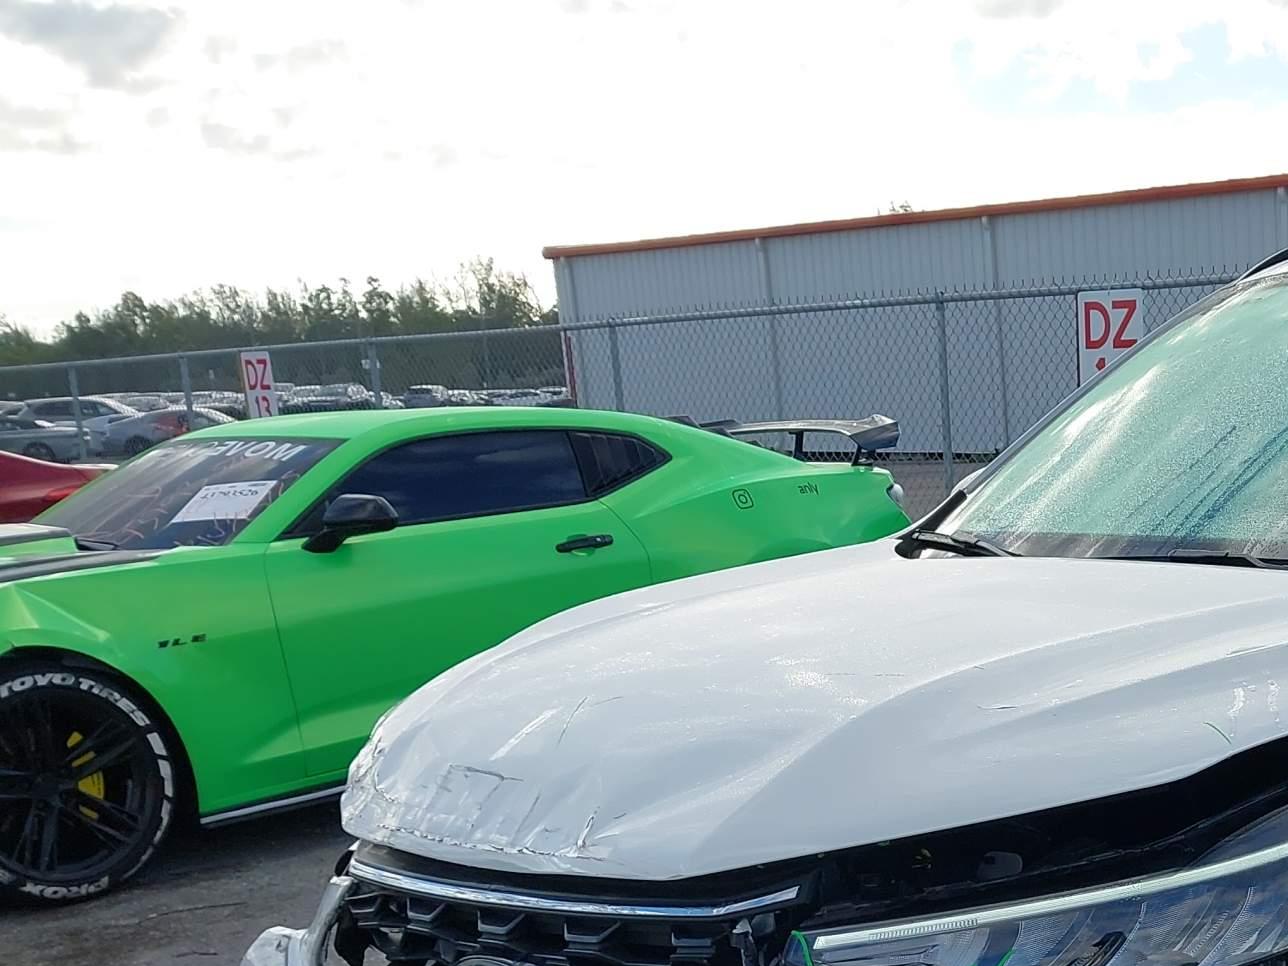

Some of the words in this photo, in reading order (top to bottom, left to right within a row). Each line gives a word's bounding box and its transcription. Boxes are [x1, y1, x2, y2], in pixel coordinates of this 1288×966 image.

[1084, 300, 1138, 349] DZ
[245, 359, 271, 390] DZ
[0, 673, 76, 698] TOYO
